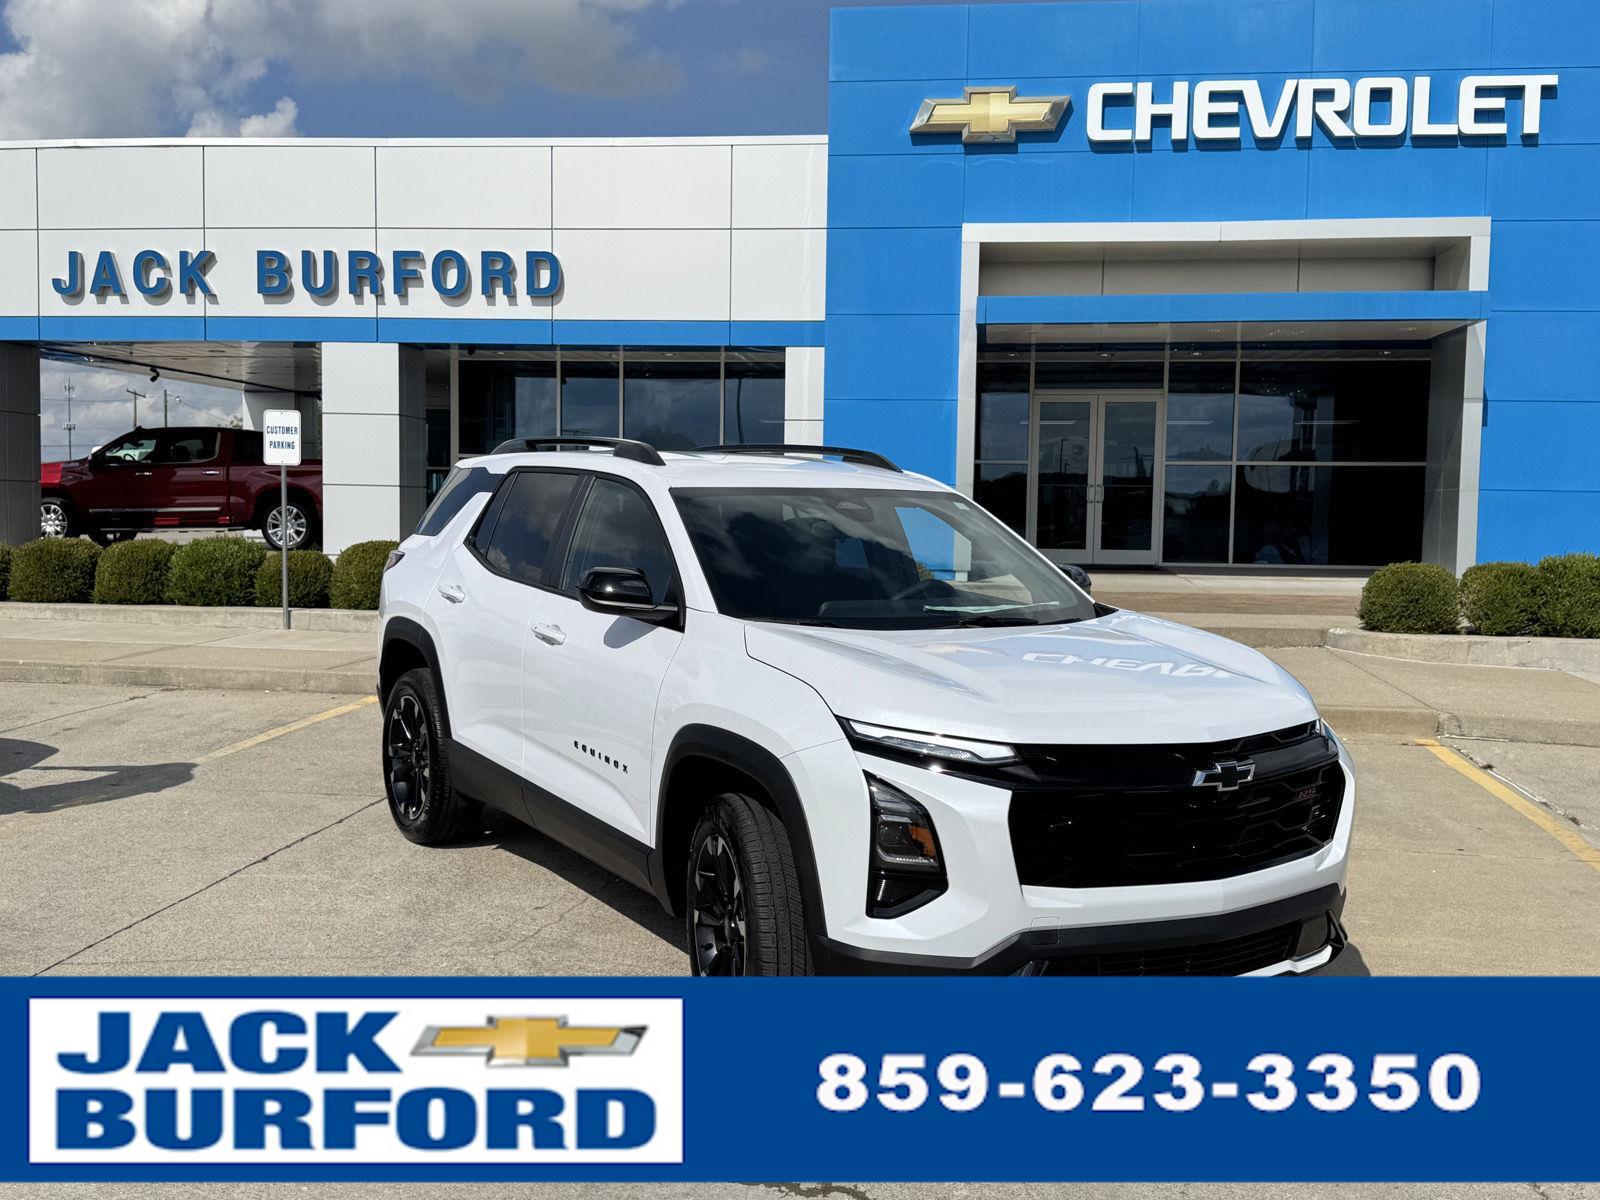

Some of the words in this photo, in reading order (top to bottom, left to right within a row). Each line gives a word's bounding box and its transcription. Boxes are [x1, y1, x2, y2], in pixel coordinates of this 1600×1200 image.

[1086, 75, 1559, 141] CHEVROLET
[52, 250, 214, 300] JACK
[257, 250, 562, 301] BURFORD
[266, 425, 299, 435] CUSTOMER
[269, 440, 296, 450] PARKING
[573, 739, 629, 775] EQUINOX
